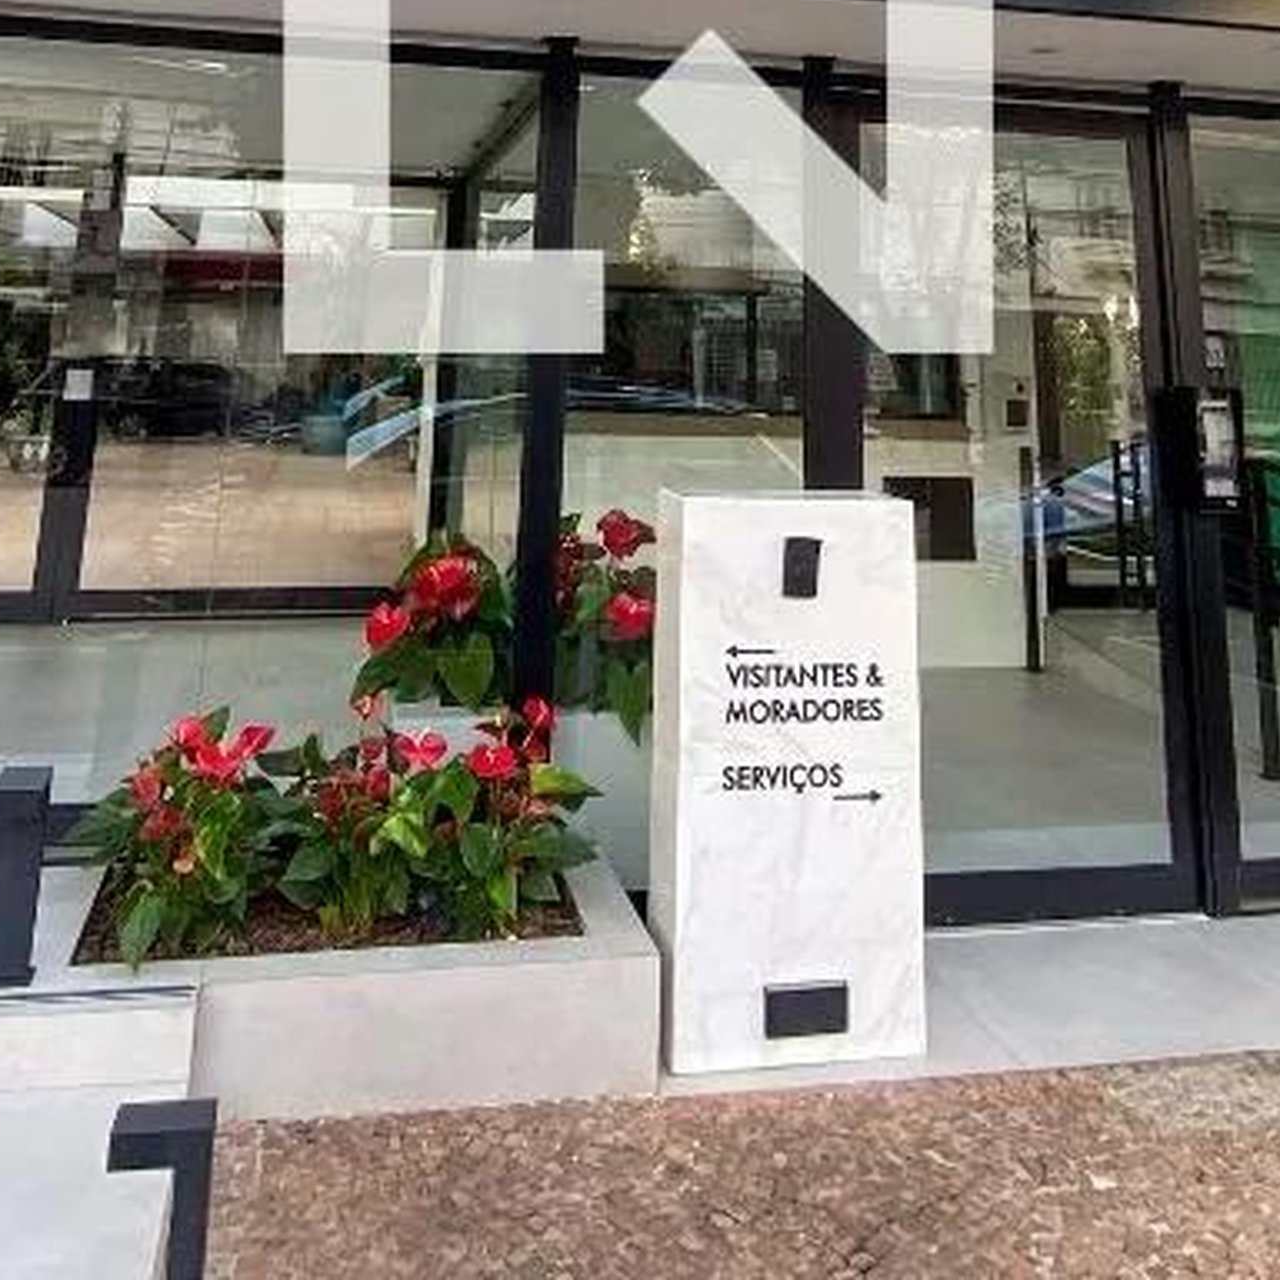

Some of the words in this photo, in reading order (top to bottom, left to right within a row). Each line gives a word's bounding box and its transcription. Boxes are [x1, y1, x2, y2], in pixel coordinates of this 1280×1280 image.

[725, 662, 858, 688] VISITANTES
[865, 662, 885, 687] &
[725, 697, 884, 724] MORADORES
[722, 762, 844, 794] SERVIÇOS
